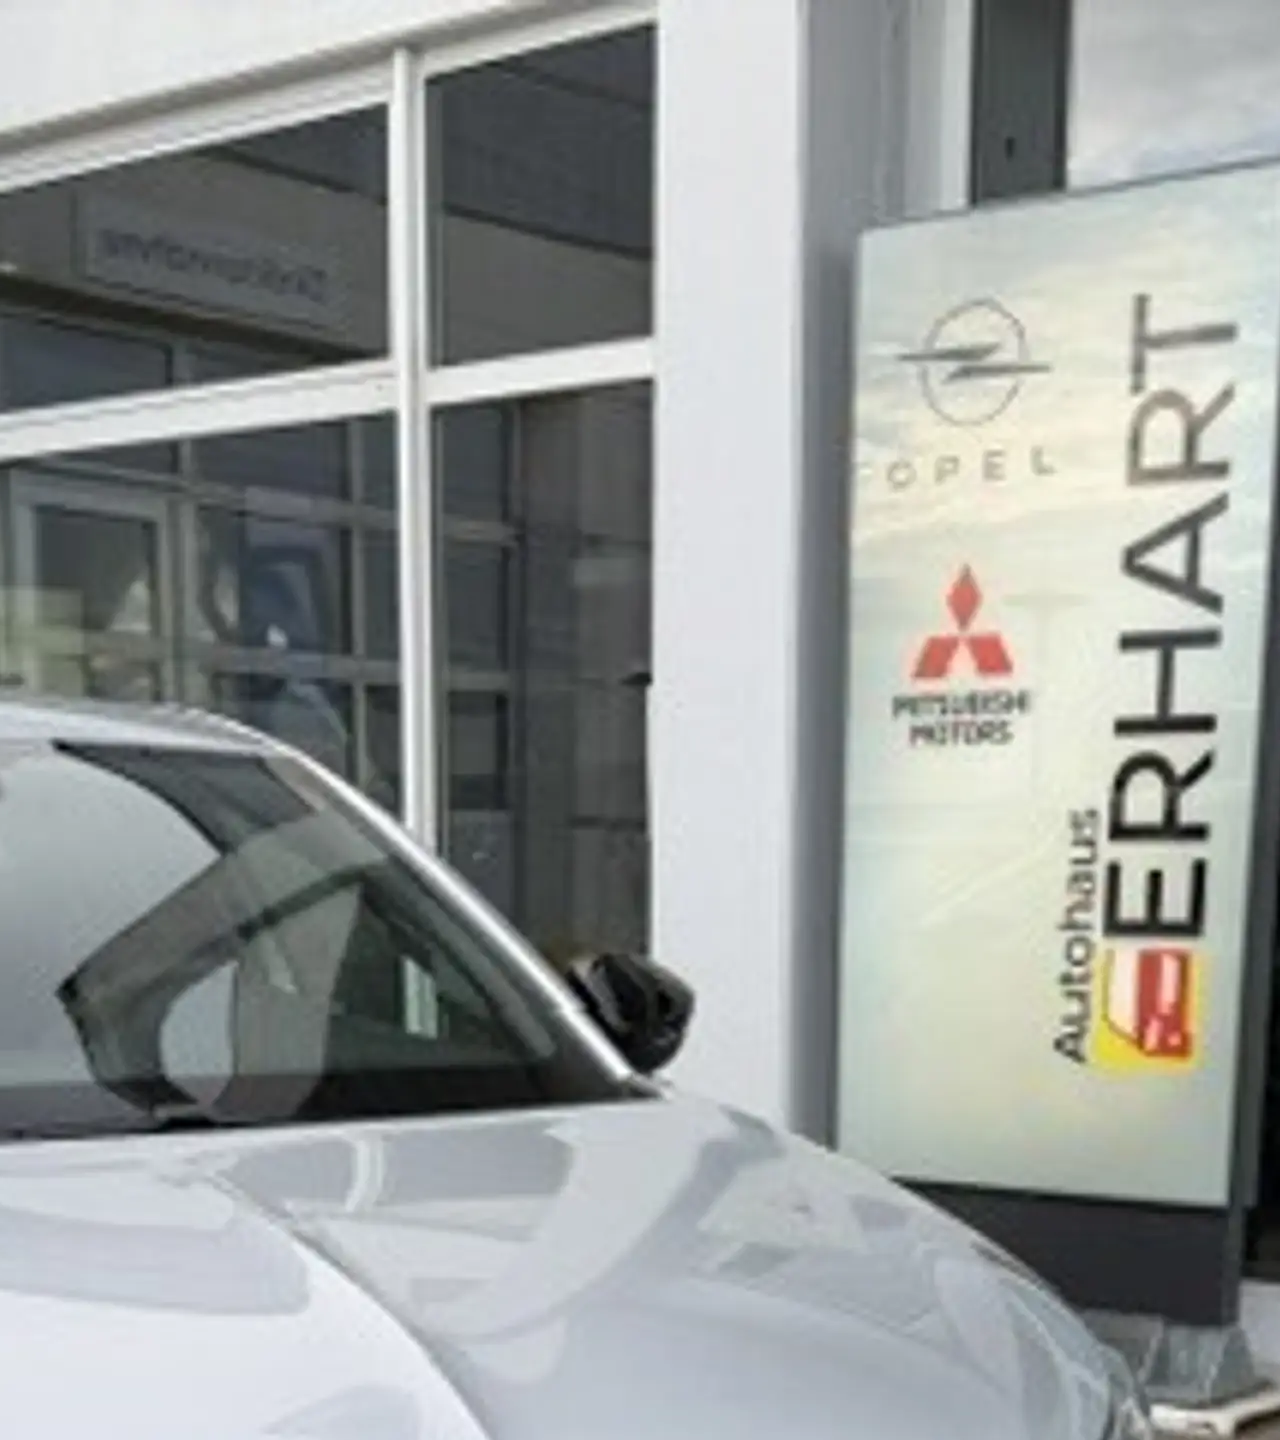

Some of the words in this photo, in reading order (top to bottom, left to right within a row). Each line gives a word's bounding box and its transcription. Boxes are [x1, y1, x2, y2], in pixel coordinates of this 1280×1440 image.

[885, 446, 1057, 490] OPEL
[1102, 292, 1239, 938] ERHART
[1052, 808, 1098, 1065] Autohaus
